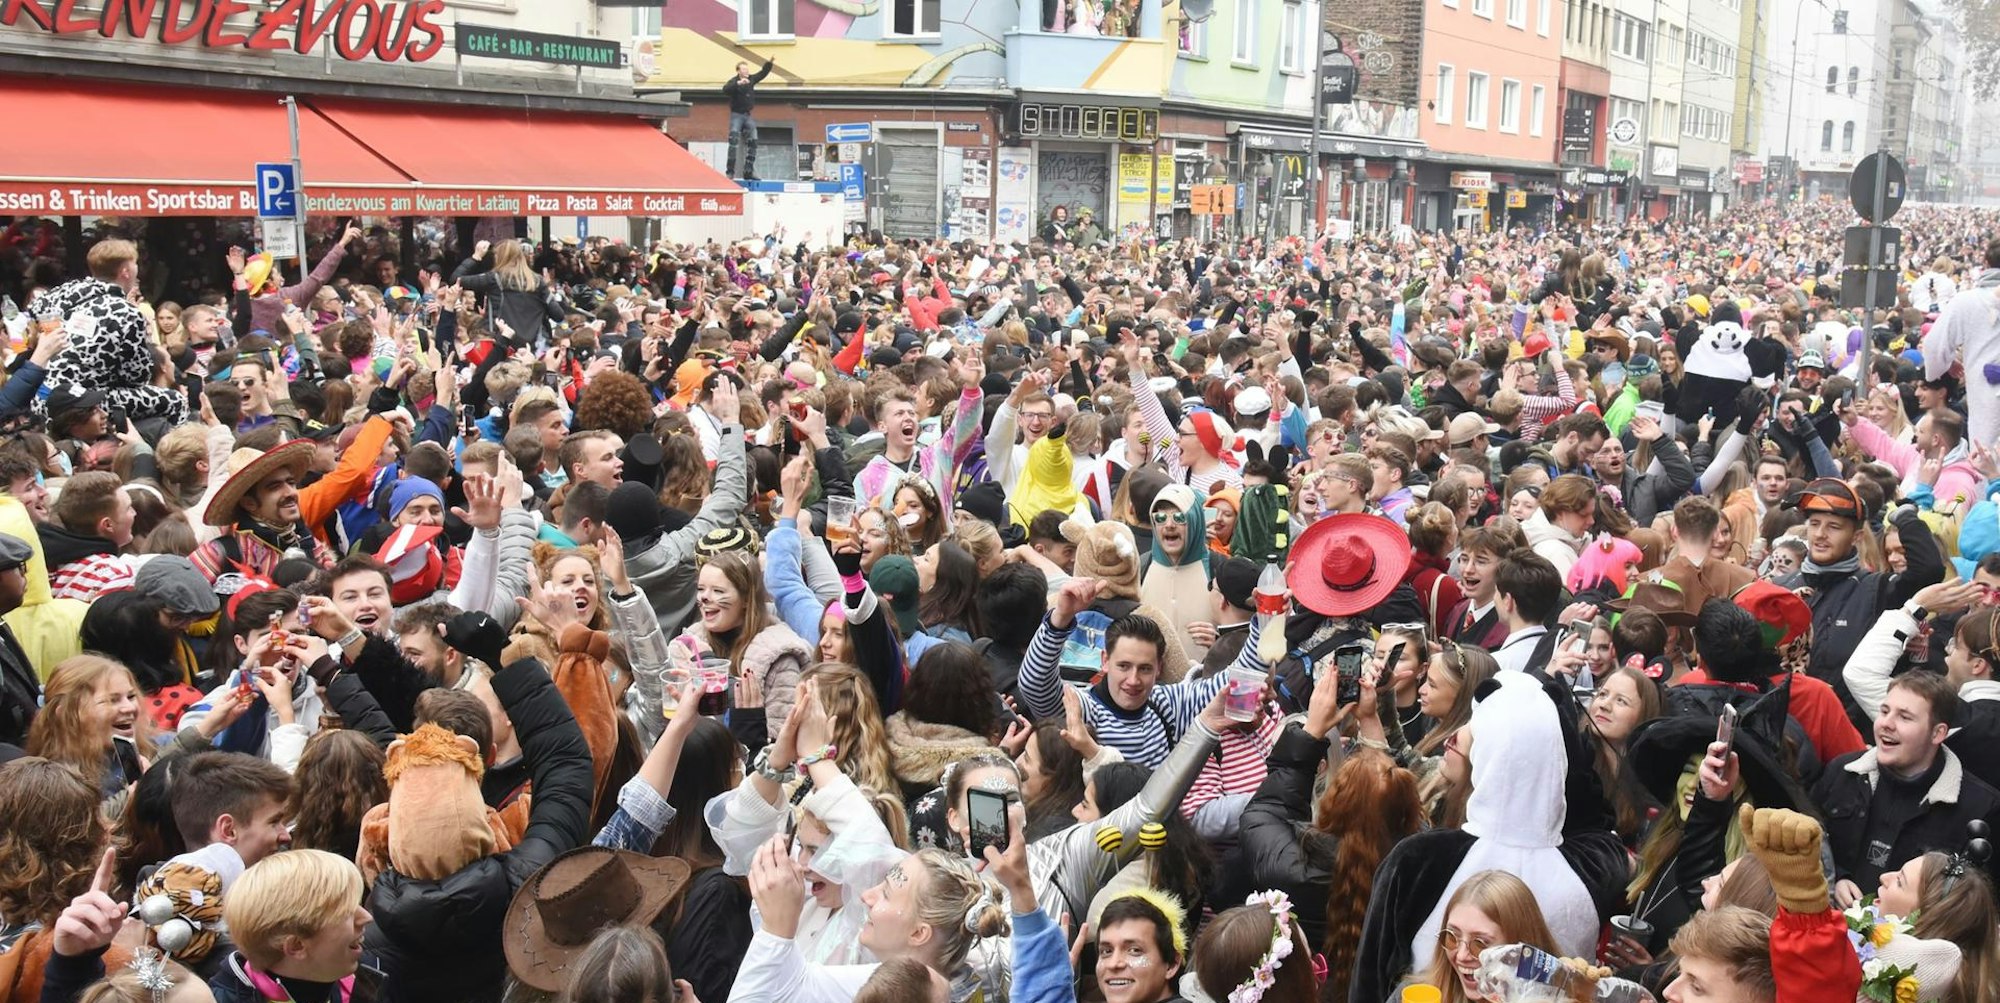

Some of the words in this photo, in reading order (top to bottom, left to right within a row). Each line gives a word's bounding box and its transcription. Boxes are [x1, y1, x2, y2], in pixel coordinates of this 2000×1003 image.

[468, 33, 499, 53] CAFÉ
[509, 38, 533, 57] BAR
[543, 42, 615, 64] RESTAURANT
[1023, 107, 1157, 137] STIEFEL
[843, 166, 854, 181] P
[1461, 179, 1486, 187] KIOSK
[1608, 173, 1625, 184] sky
[49, 189, 66, 211] &
[69, 189, 142, 211] Trinken
[147, 189, 234, 213] Sportsbar
[240, 191, 258, 211] Bu
[263, 170, 285, 211] P
[303, 193, 386, 211] Rendezvous
[391, 197, 411, 211] am
[416, 194, 473, 212] Kwartier
[477, 194, 520, 214] Latäng
[527, 195, 559, 211] Pizza
[566, 195, 598, 211] Pasta
[605, 194, 634, 211] Salat
[643, 195, 685, 212] Cocktail
